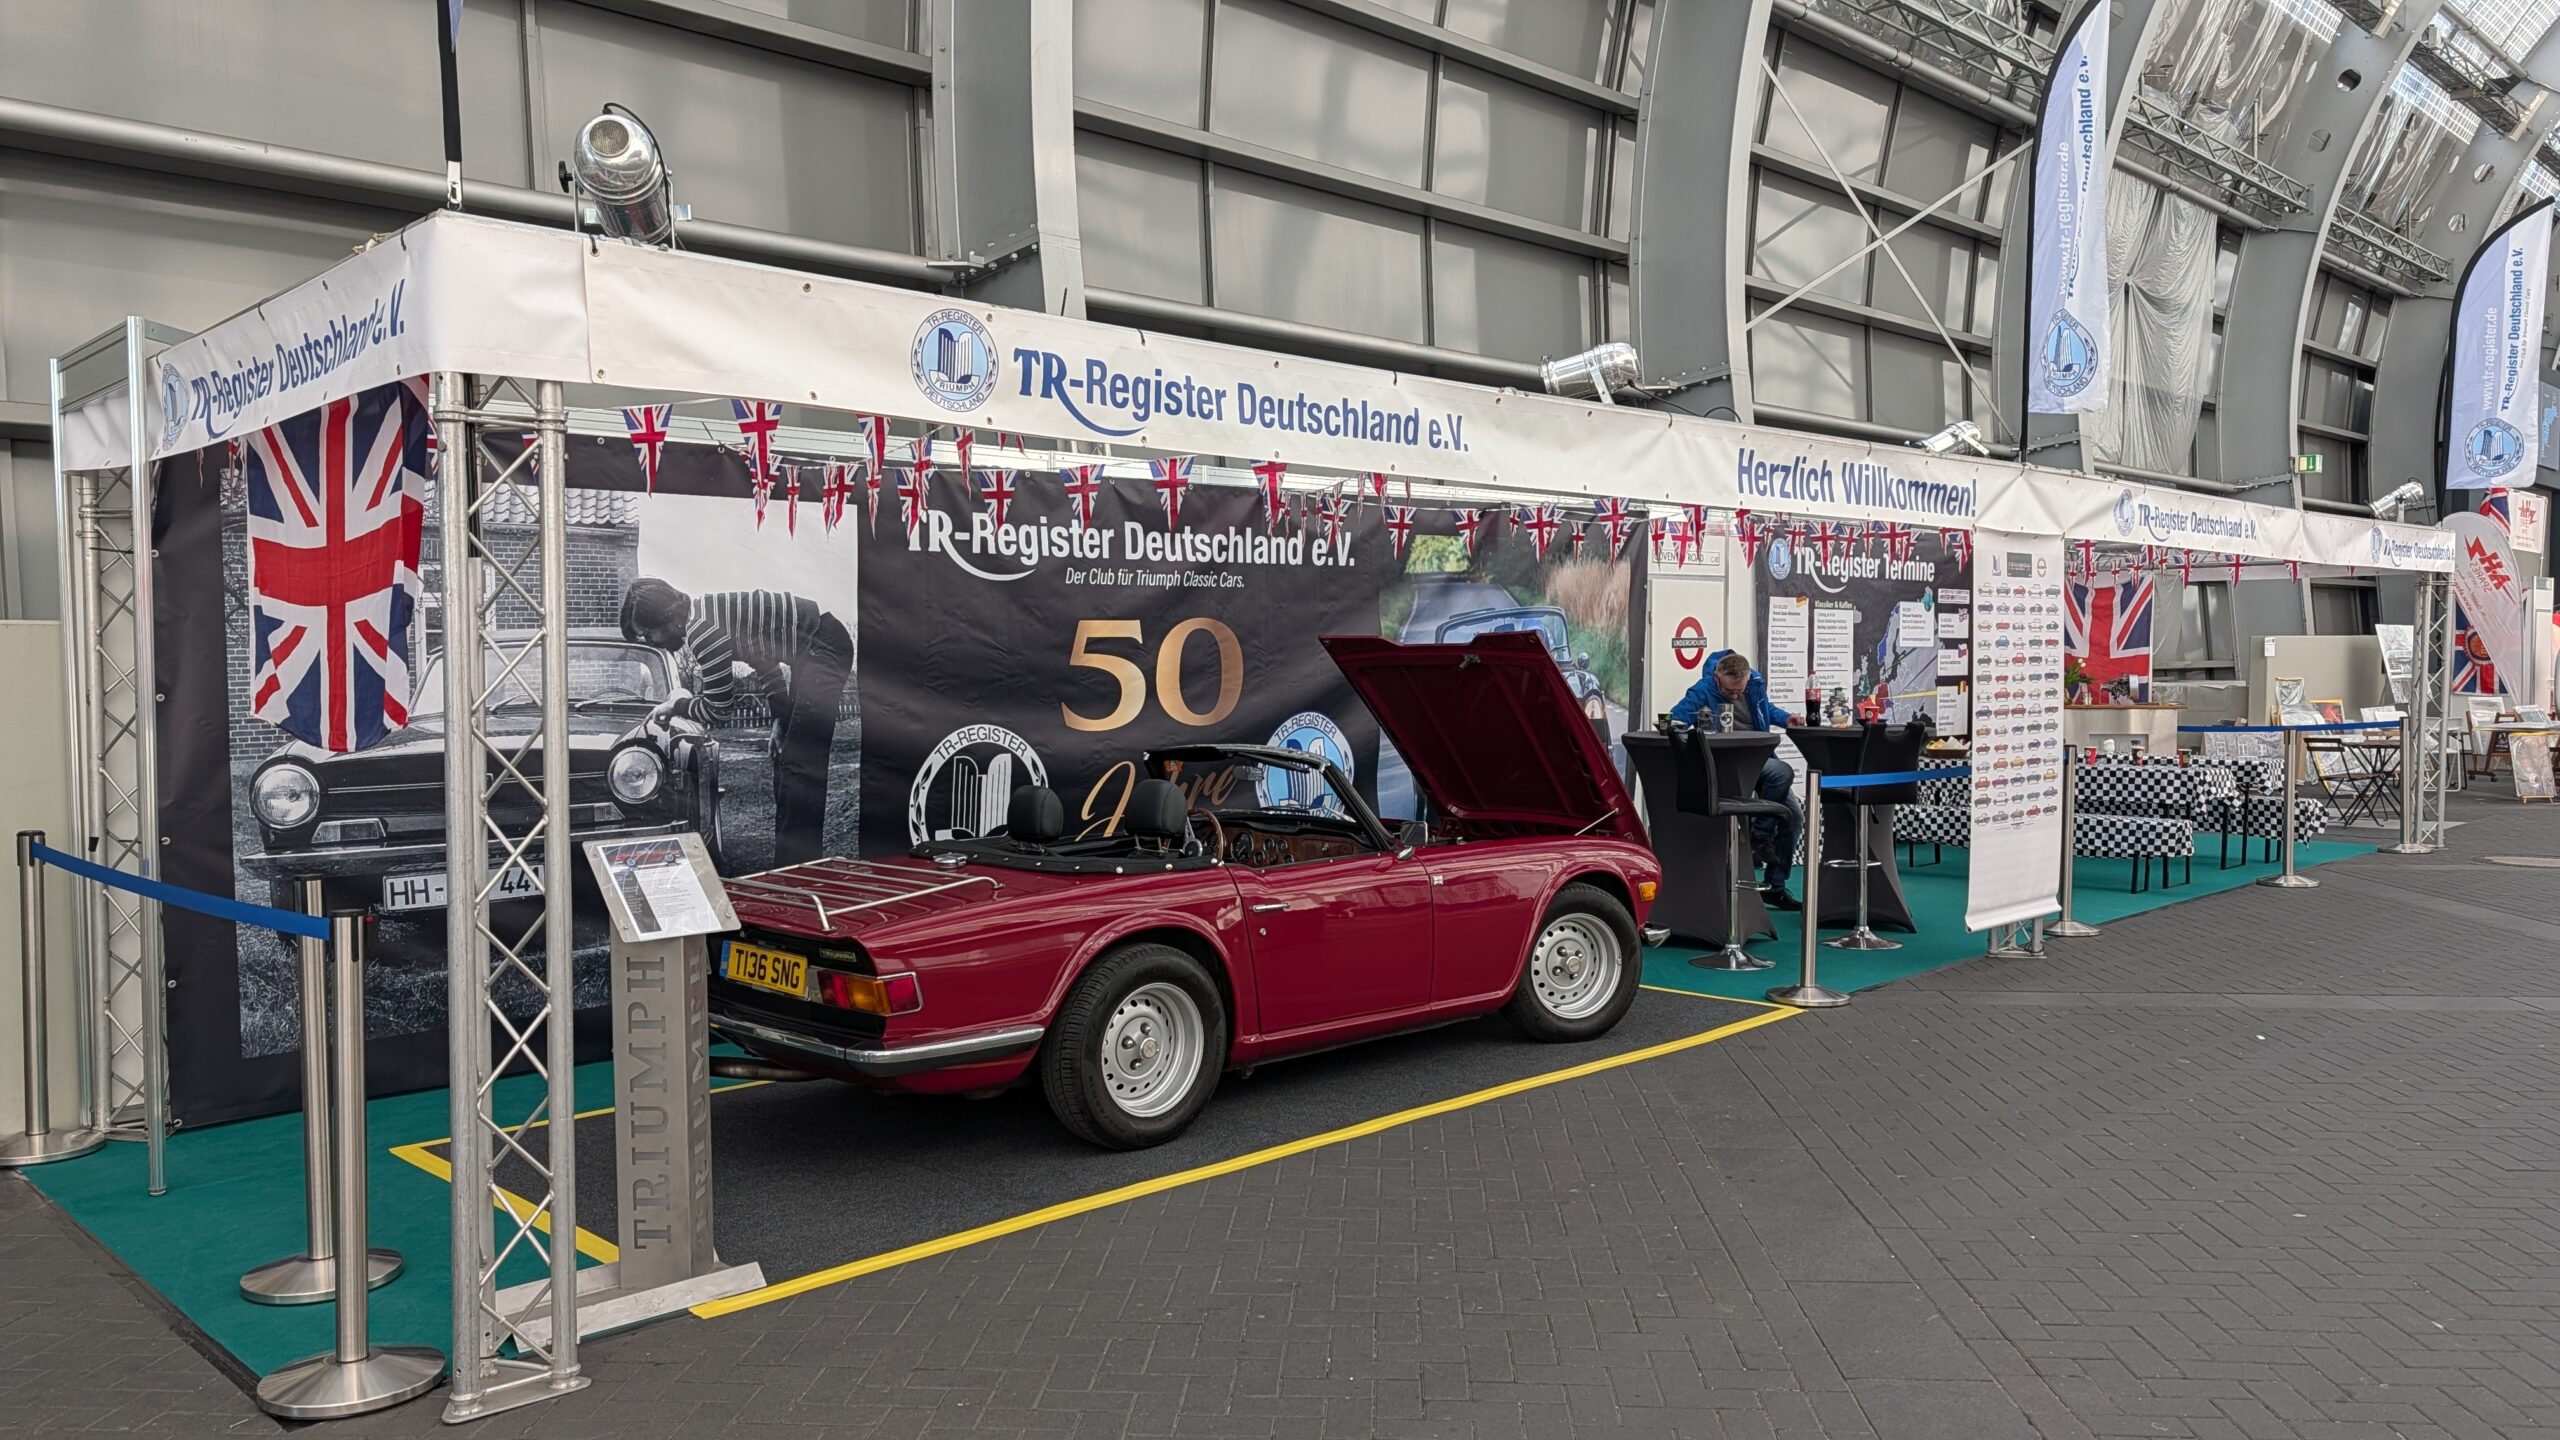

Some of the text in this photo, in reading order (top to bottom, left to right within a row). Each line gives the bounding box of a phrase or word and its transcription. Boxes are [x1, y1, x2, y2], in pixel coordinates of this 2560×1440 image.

[2059, 142, 2074, 295] www.tr-register.de
[927, 311, 984, 336] TR-REGISTER
[2501, 248, 2524, 411] TR-Register Deutschland e.V.
[191, 356, 274, 440] TR-Register
[275, 298, 379, 392] Deutschland
[372, 278, 405, 345] e.V.
[2482, 307, 2497, 410] www.tr-register.de
[924, 386, 984, 410] DEUTSCHLAND
[934, 378, 976, 391] TRIUMPH
[1013, 347, 1469, 452] TR-Register Deutschland e.V.
[1737, 447, 1977, 518] Herzlich Willkommen!
[2138, 504, 2189, 542] TR-Register
[2191, 512, 2243, 539] Deutschland
[2245, 520, 2257, 540] e.V.
[908, 509, 1355, 581] TR-Register Deutschland e.V.
[1065, 567, 1245, 590] Der Club für Triumph Classic Cars.
[1794, 547, 1880, 593] TR-Register
[1883, 554, 1935, 583] Termine
[1673, 639, 1707, 647] UNDERGROUND
[1060, 617, 1245, 731] 50
[934, 727, 1028, 760] TR-REGISTER
[1274, 714, 1337, 741] TR-REGISTER
[390, 879, 430, 907] HH
[735, 949, 801, 989] T136 SNG
[821, 950, 855, 960] TRIUMPH
[626, 956, 672, 1250] TRIUMPH
